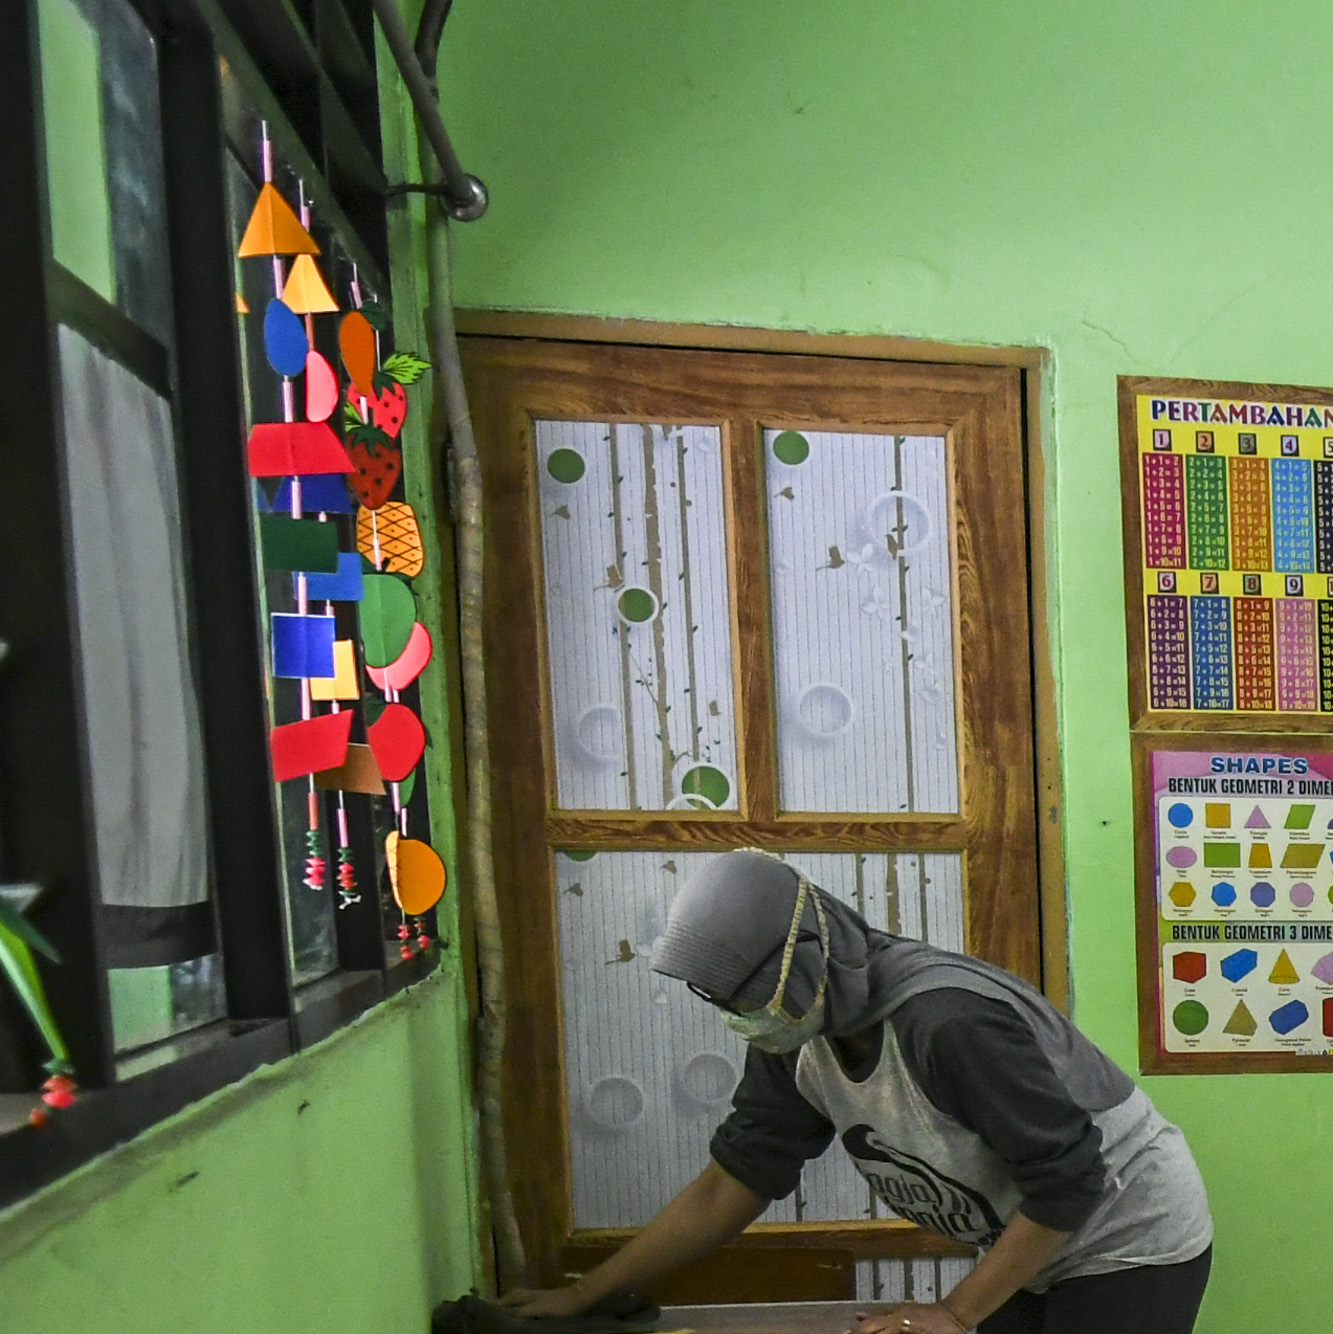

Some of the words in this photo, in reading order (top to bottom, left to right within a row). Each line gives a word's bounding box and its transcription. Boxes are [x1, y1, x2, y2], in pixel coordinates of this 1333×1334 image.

[1210, 756, 1308, 774] SHAPES
[1168, 778, 1217, 794] BENTUK
[1221, 778, 1283, 795] GEOMETRI
[1287, 780, 1295, 795] 2
[1172, 925, 1220, 939] BENTUK
[1224, 925, 1285, 940] GEOMETRI
[1290, 925, 1297, 940] 3
